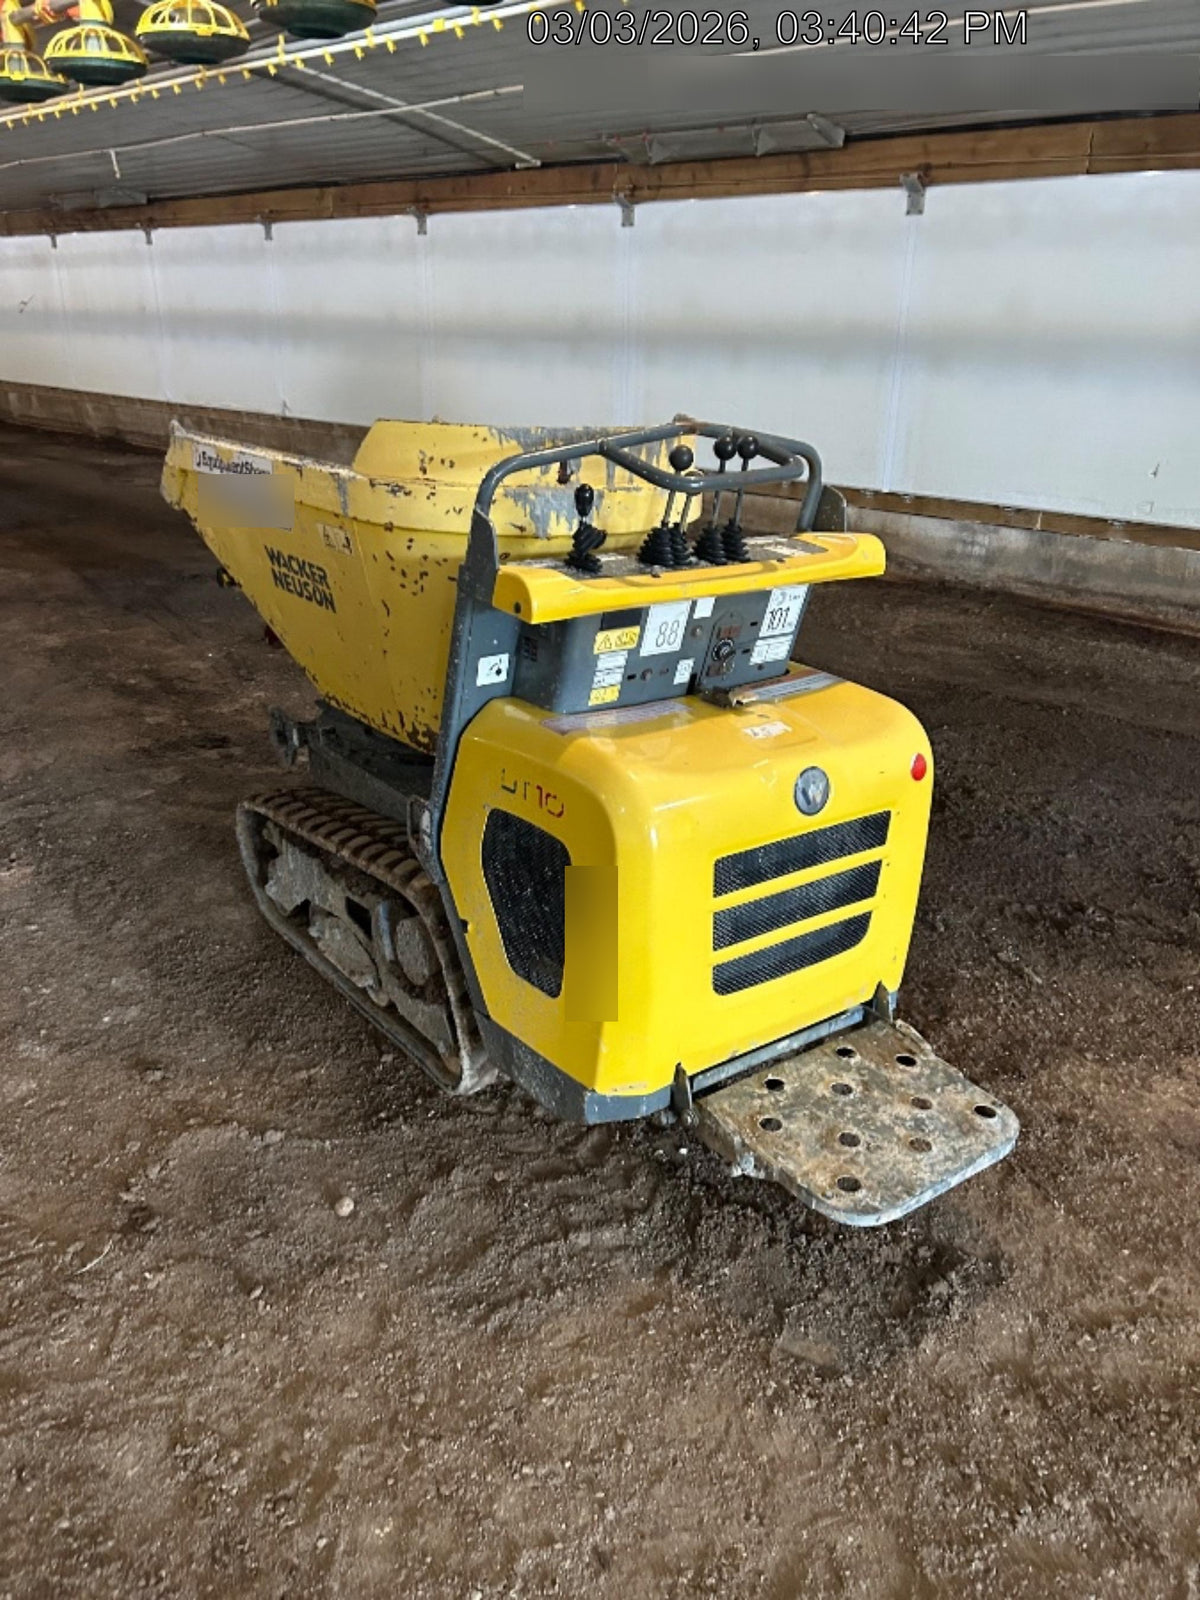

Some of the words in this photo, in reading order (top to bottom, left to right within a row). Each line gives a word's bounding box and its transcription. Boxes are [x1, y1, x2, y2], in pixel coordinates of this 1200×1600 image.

[202, 450, 272, 476] EquipmentSha
[264, 545, 331, 592] WACKER
[271, 567, 337, 614] NEUSON
